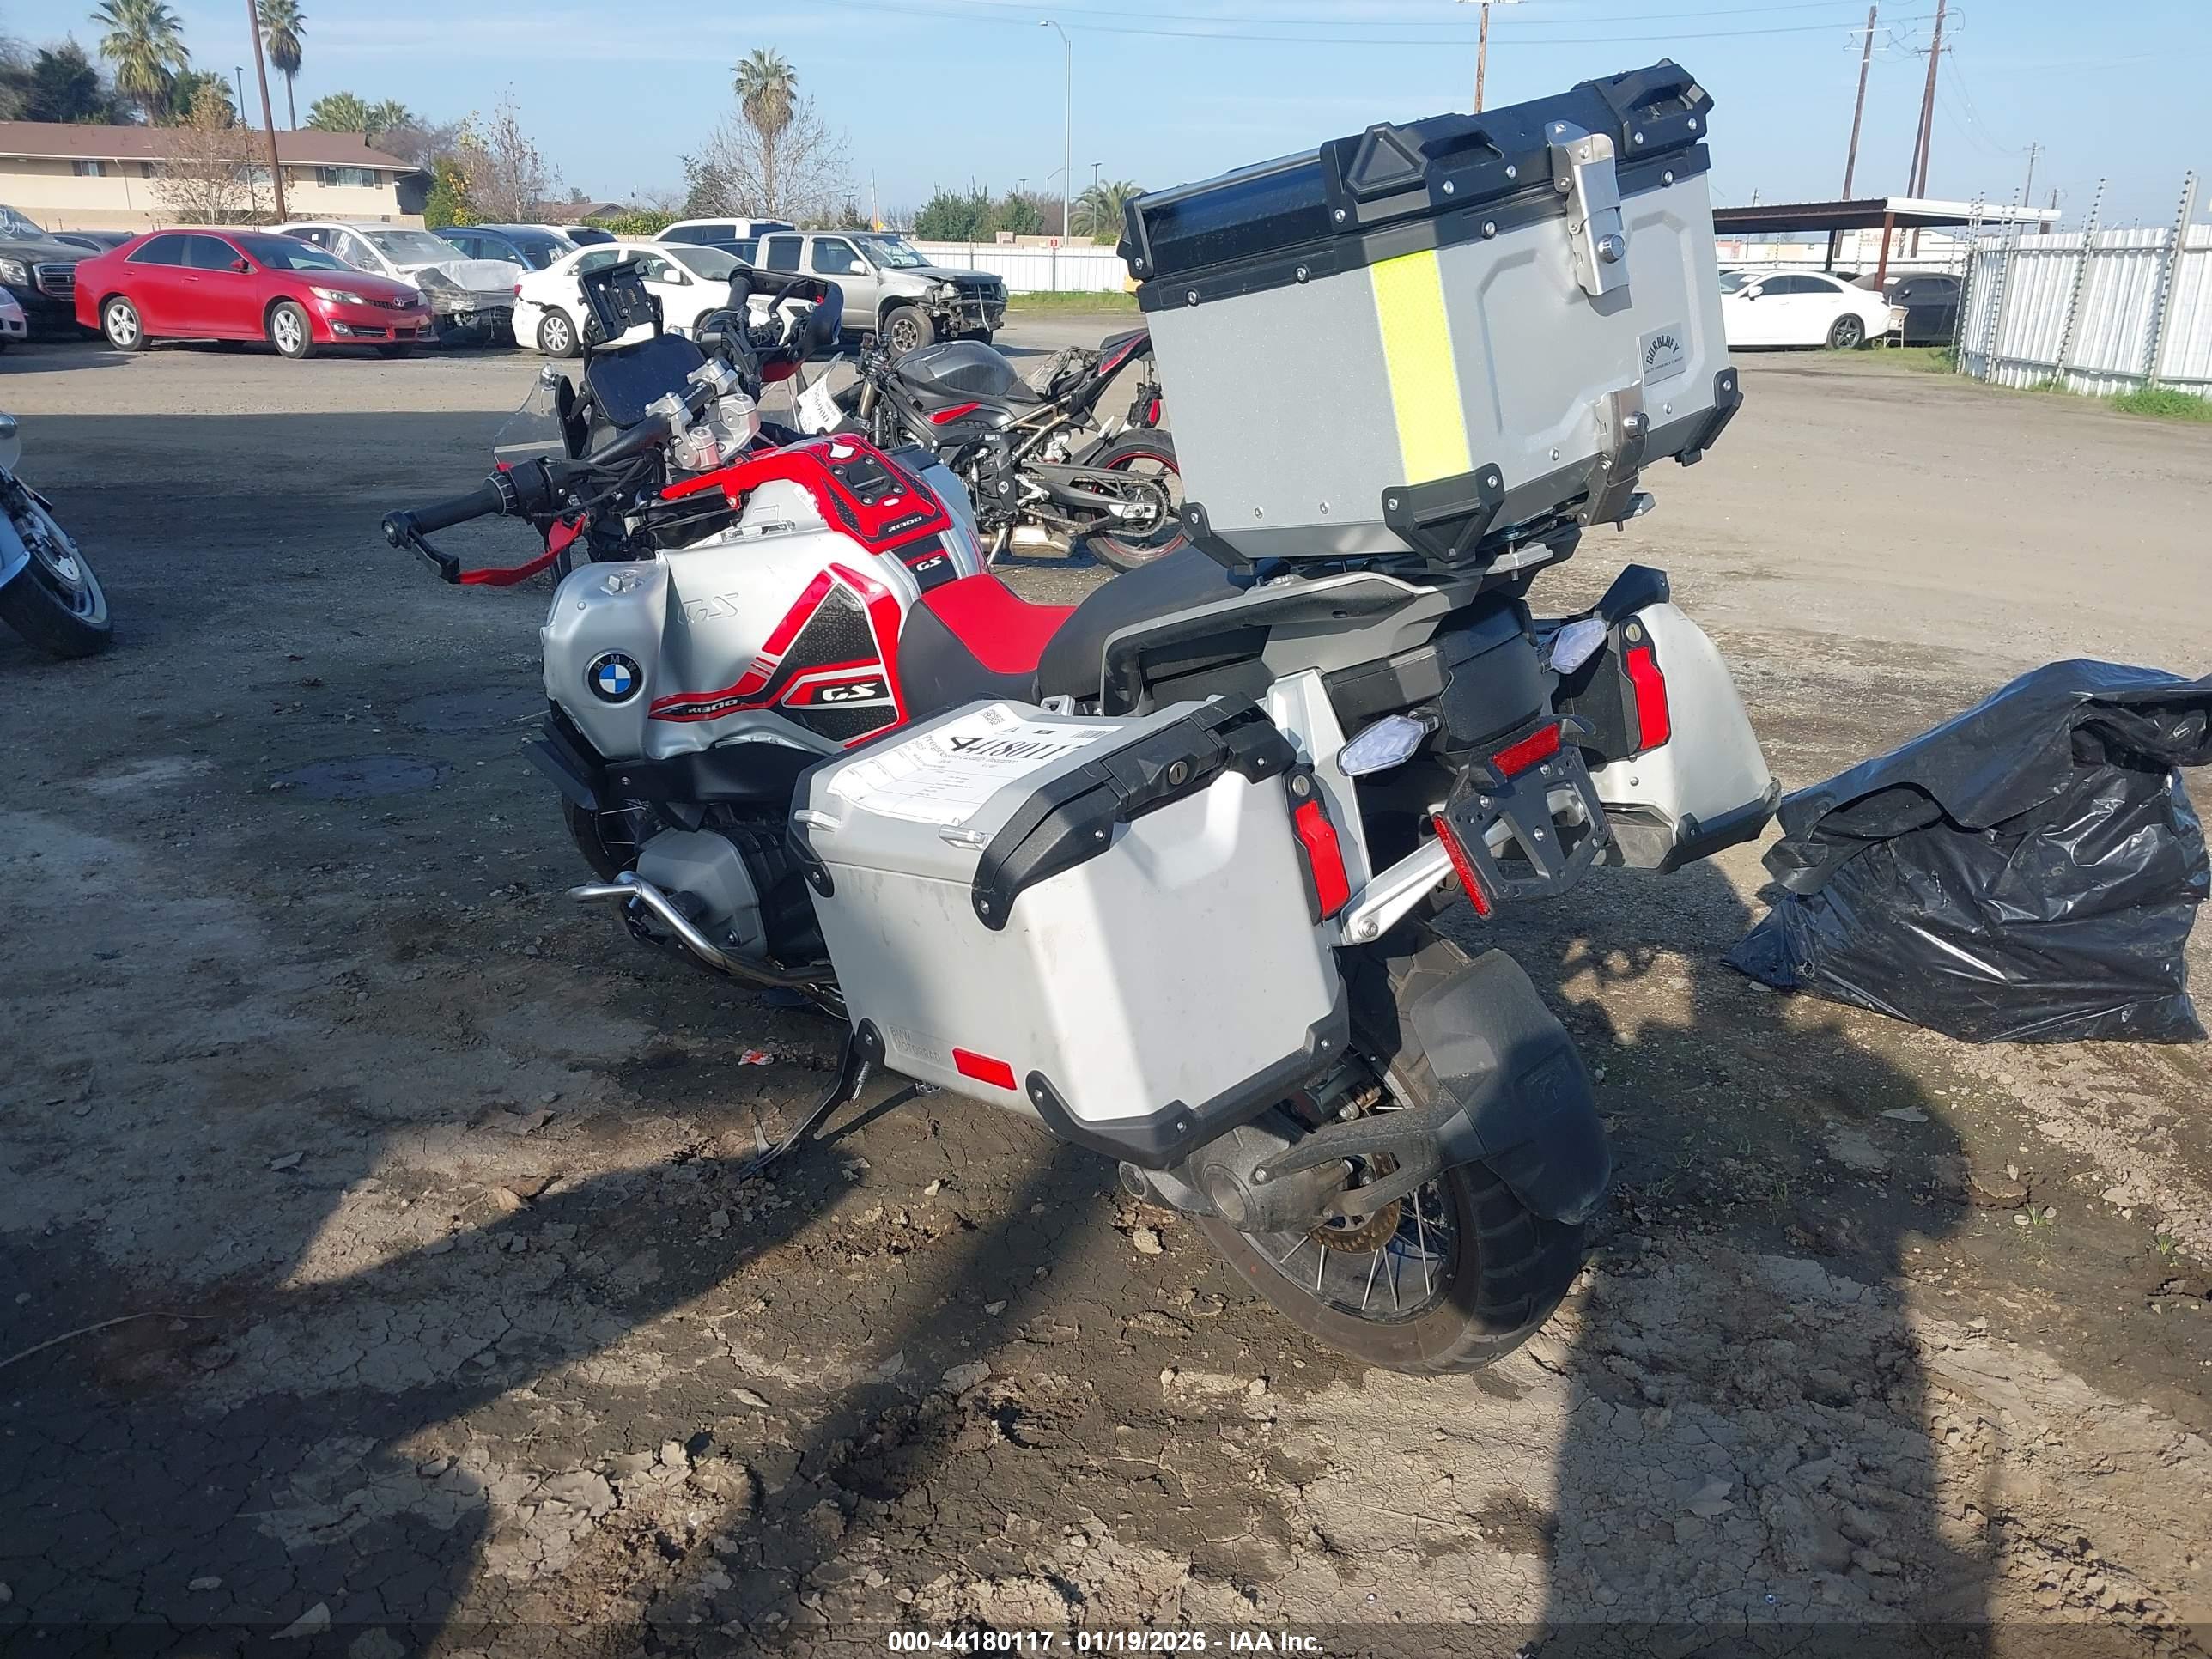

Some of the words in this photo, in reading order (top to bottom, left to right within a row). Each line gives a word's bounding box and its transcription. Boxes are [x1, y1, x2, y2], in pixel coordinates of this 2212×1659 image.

[916, 556, 942, 571] GS
[593, 655, 637, 673] BMW
[822, 683, 878, 701] GS
[891, 1027, 912, 1041] BMW
[895, 1037, 941, 1061] MOTORRAD
